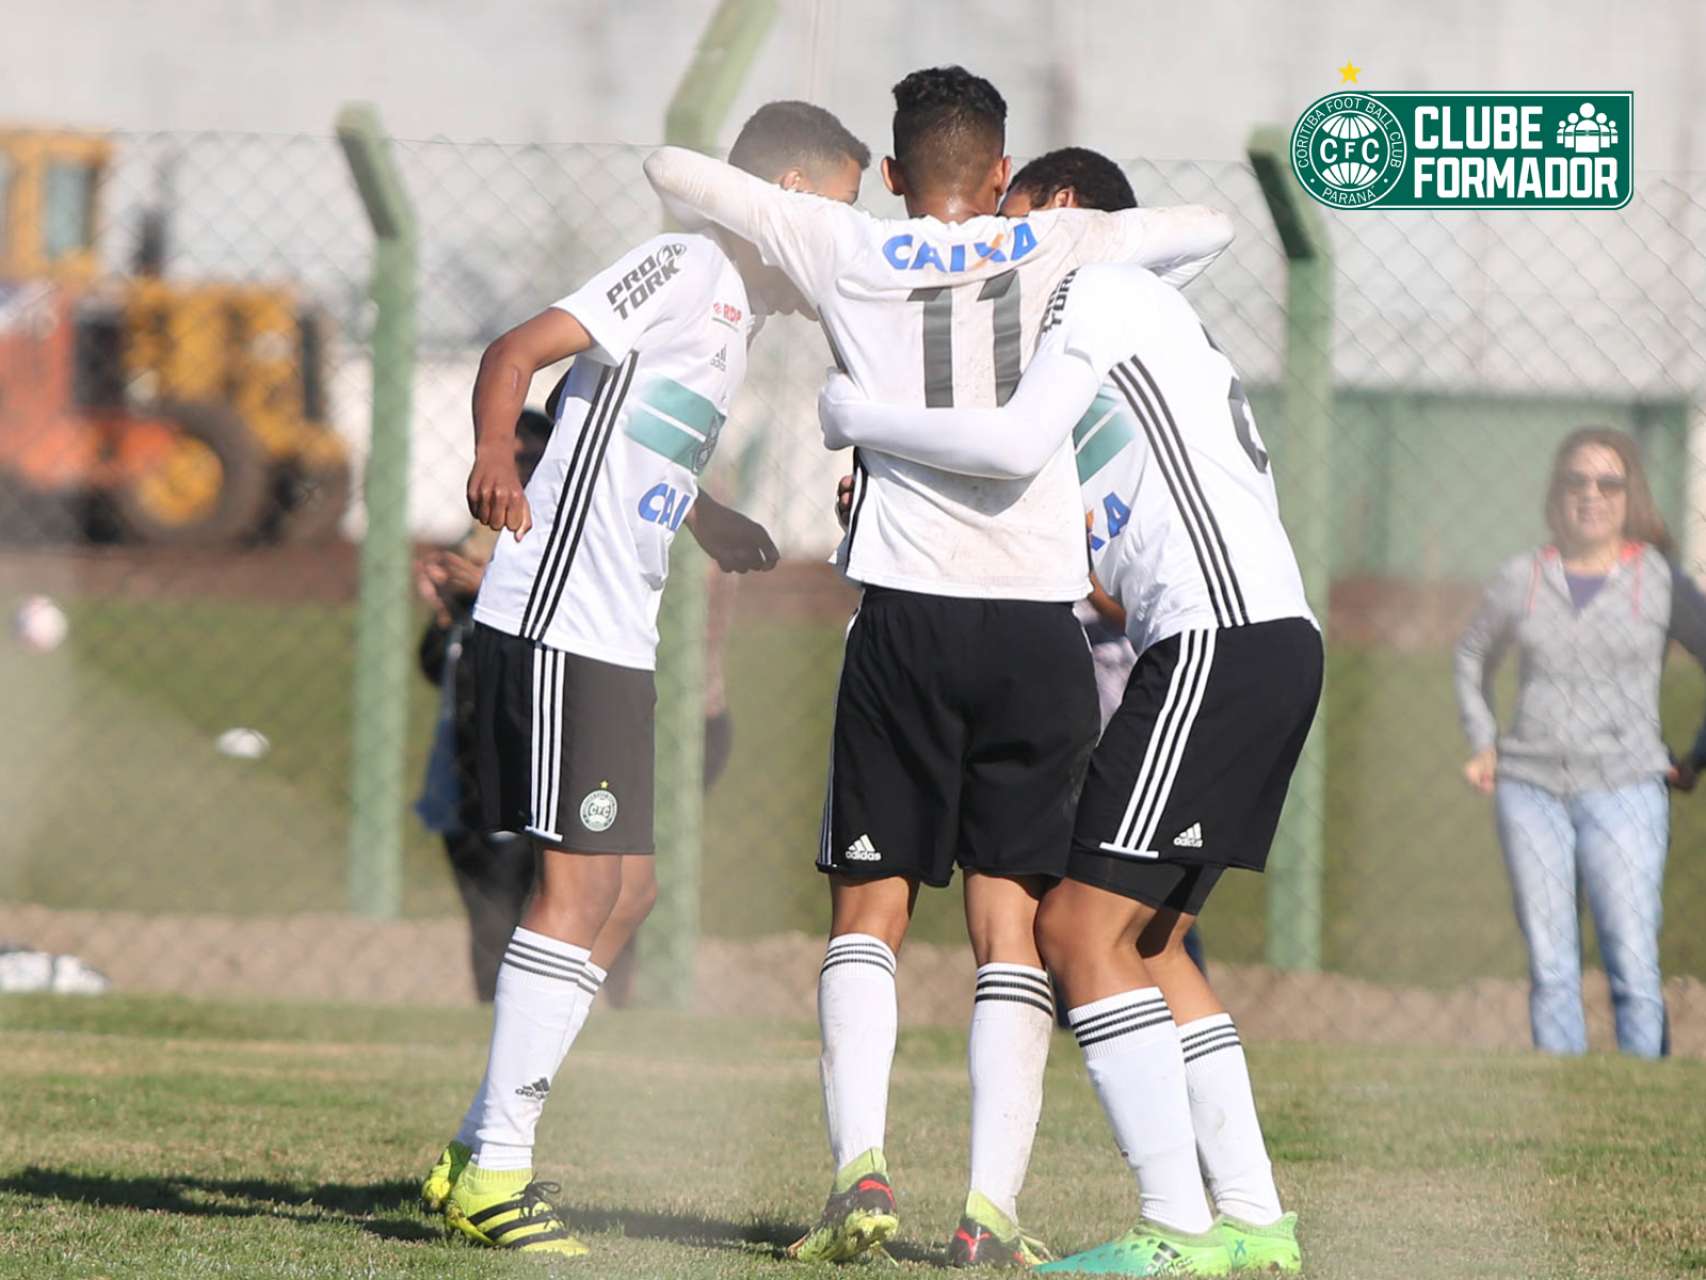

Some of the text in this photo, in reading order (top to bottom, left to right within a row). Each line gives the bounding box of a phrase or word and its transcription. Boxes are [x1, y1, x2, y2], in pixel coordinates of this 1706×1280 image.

[882, 222, 1039, 273] CAIXA
[606, 255, 658, 306] PRO
[613, 258, 681, 321] TORK
[906, 269, 1022, 409] 11
[845, 850, 882, 861] adidas
